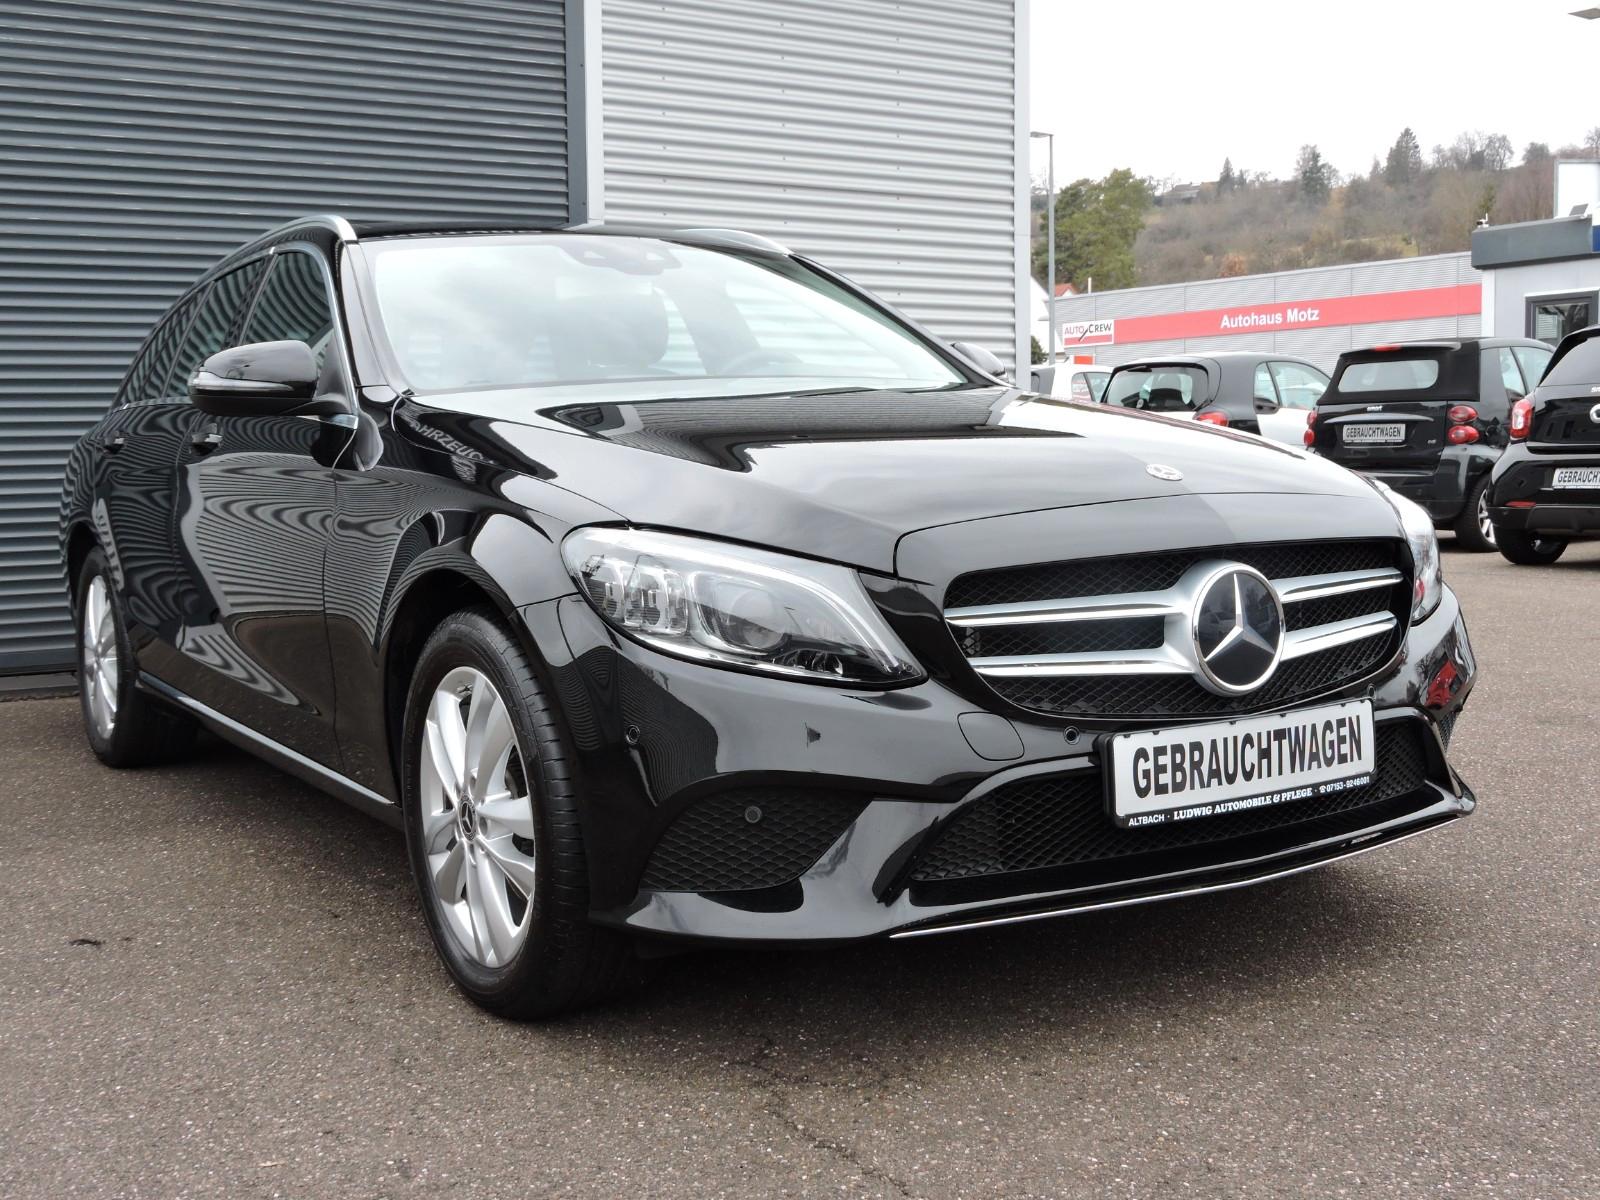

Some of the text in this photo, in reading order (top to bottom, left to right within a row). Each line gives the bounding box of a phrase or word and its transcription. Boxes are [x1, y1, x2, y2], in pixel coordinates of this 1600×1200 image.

[1220, 308, 1320, 329] Autohaus Motz
[1064, 323, 1112, 335] AUTO CREW
[1346, 426, 1402, 438] GEBRAUCHTWAGEN
[1557, 469, 1600, 483] GEBRAUCH
[1132, 715, 1362, 799] GEBRAUCHTWAGEN
[1128, 813, 1165, 827] ALTBACH
[1173, 805, 1213, 820] LUDWIG
[1214, 796, 1272, 814] AUTOMOBILE
[1273, 793, 1280, 803] &
[1281, 787, 1313, 803] PFLEGE
